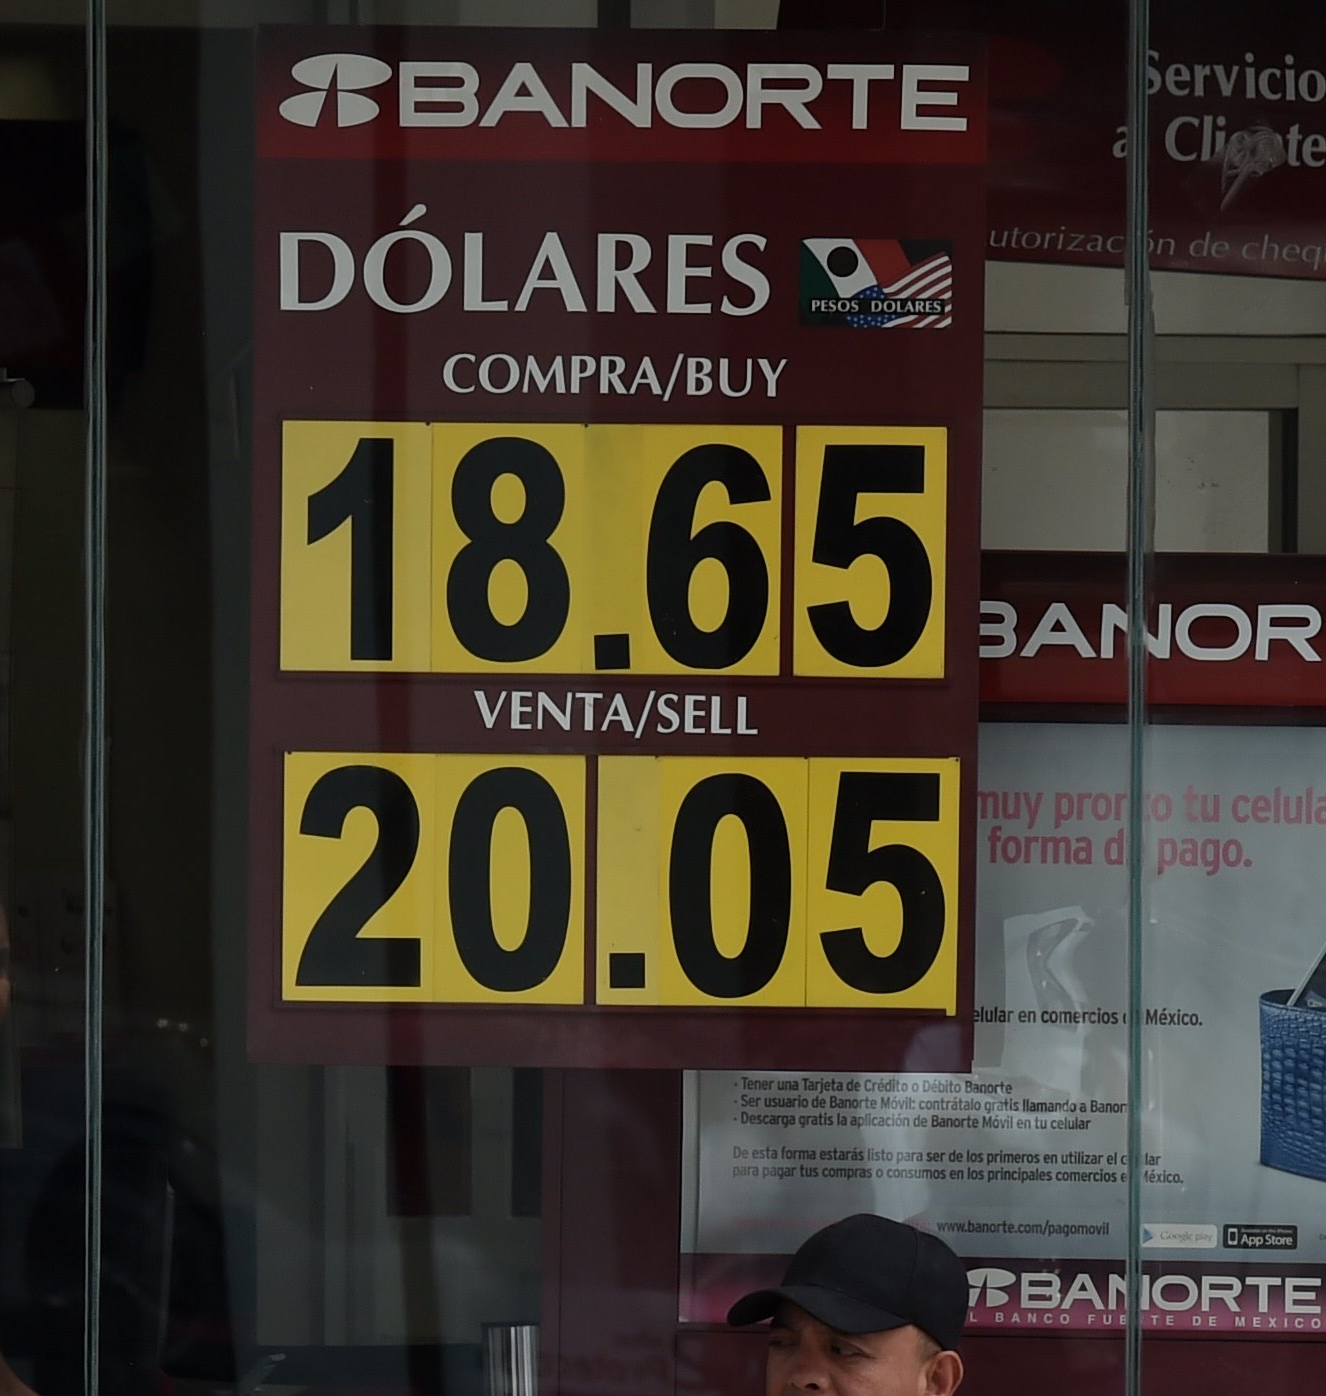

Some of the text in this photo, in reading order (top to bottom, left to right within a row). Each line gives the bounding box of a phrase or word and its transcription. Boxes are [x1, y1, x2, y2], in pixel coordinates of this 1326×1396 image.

[1146, 50, 1326, 102] Servicio
[399, 61, 969, 132] BANORTE
[1189, 232, 1230, 260] de
[279, 204, 771, 316] DÓLARES
[811, 299, 942, 314] PESOS DOLARES
[442, 353, 788, 402] COMPRA/BUY
[307, 437, 933, 670] 18.65
[474, 690, 759, 739] VENTA/SELL
[977, 790, 1043, 829] muy
[1186, 785, 1220, 823] tu
[988, 826, 1253, 876] forma pago.
[295, 765, 946, 999] 20.05
[1018, 1011, 1036, 1023] en
[1041, 1008, 1119, 1024] comercios
[1145, 1008, 1203, 1027] México.
[741, 1077, 1012, 1095] Tener una Tarjeta de Crédito o Débito Banorte
[741, 1094, 1086, 1115] Ser usuario de Banorte Móvil: contrátalo gratis llamando a
[741, 1111, 1091, 1130] Descarga gratis la aplicación de Banorte Móvil en tu celular
[733, 1146, 1117, 1165] De esta forma estarás listo para ser de los primeros en utilizar el
[733, 1164, 1117, 1183] para pagar tus compras o consumos en los principales comercios
[937, 1220, 1110, 1238] www.banorte.com/pagomovil
[1160, 1230, 1213, 1243] Google play
[1240, 1234, 1293, 1247] App Store
[1020, 1273, 1322, 1314] BANORTE
[995, 1312, 1322, 1329] BANCO DE MEXICO
